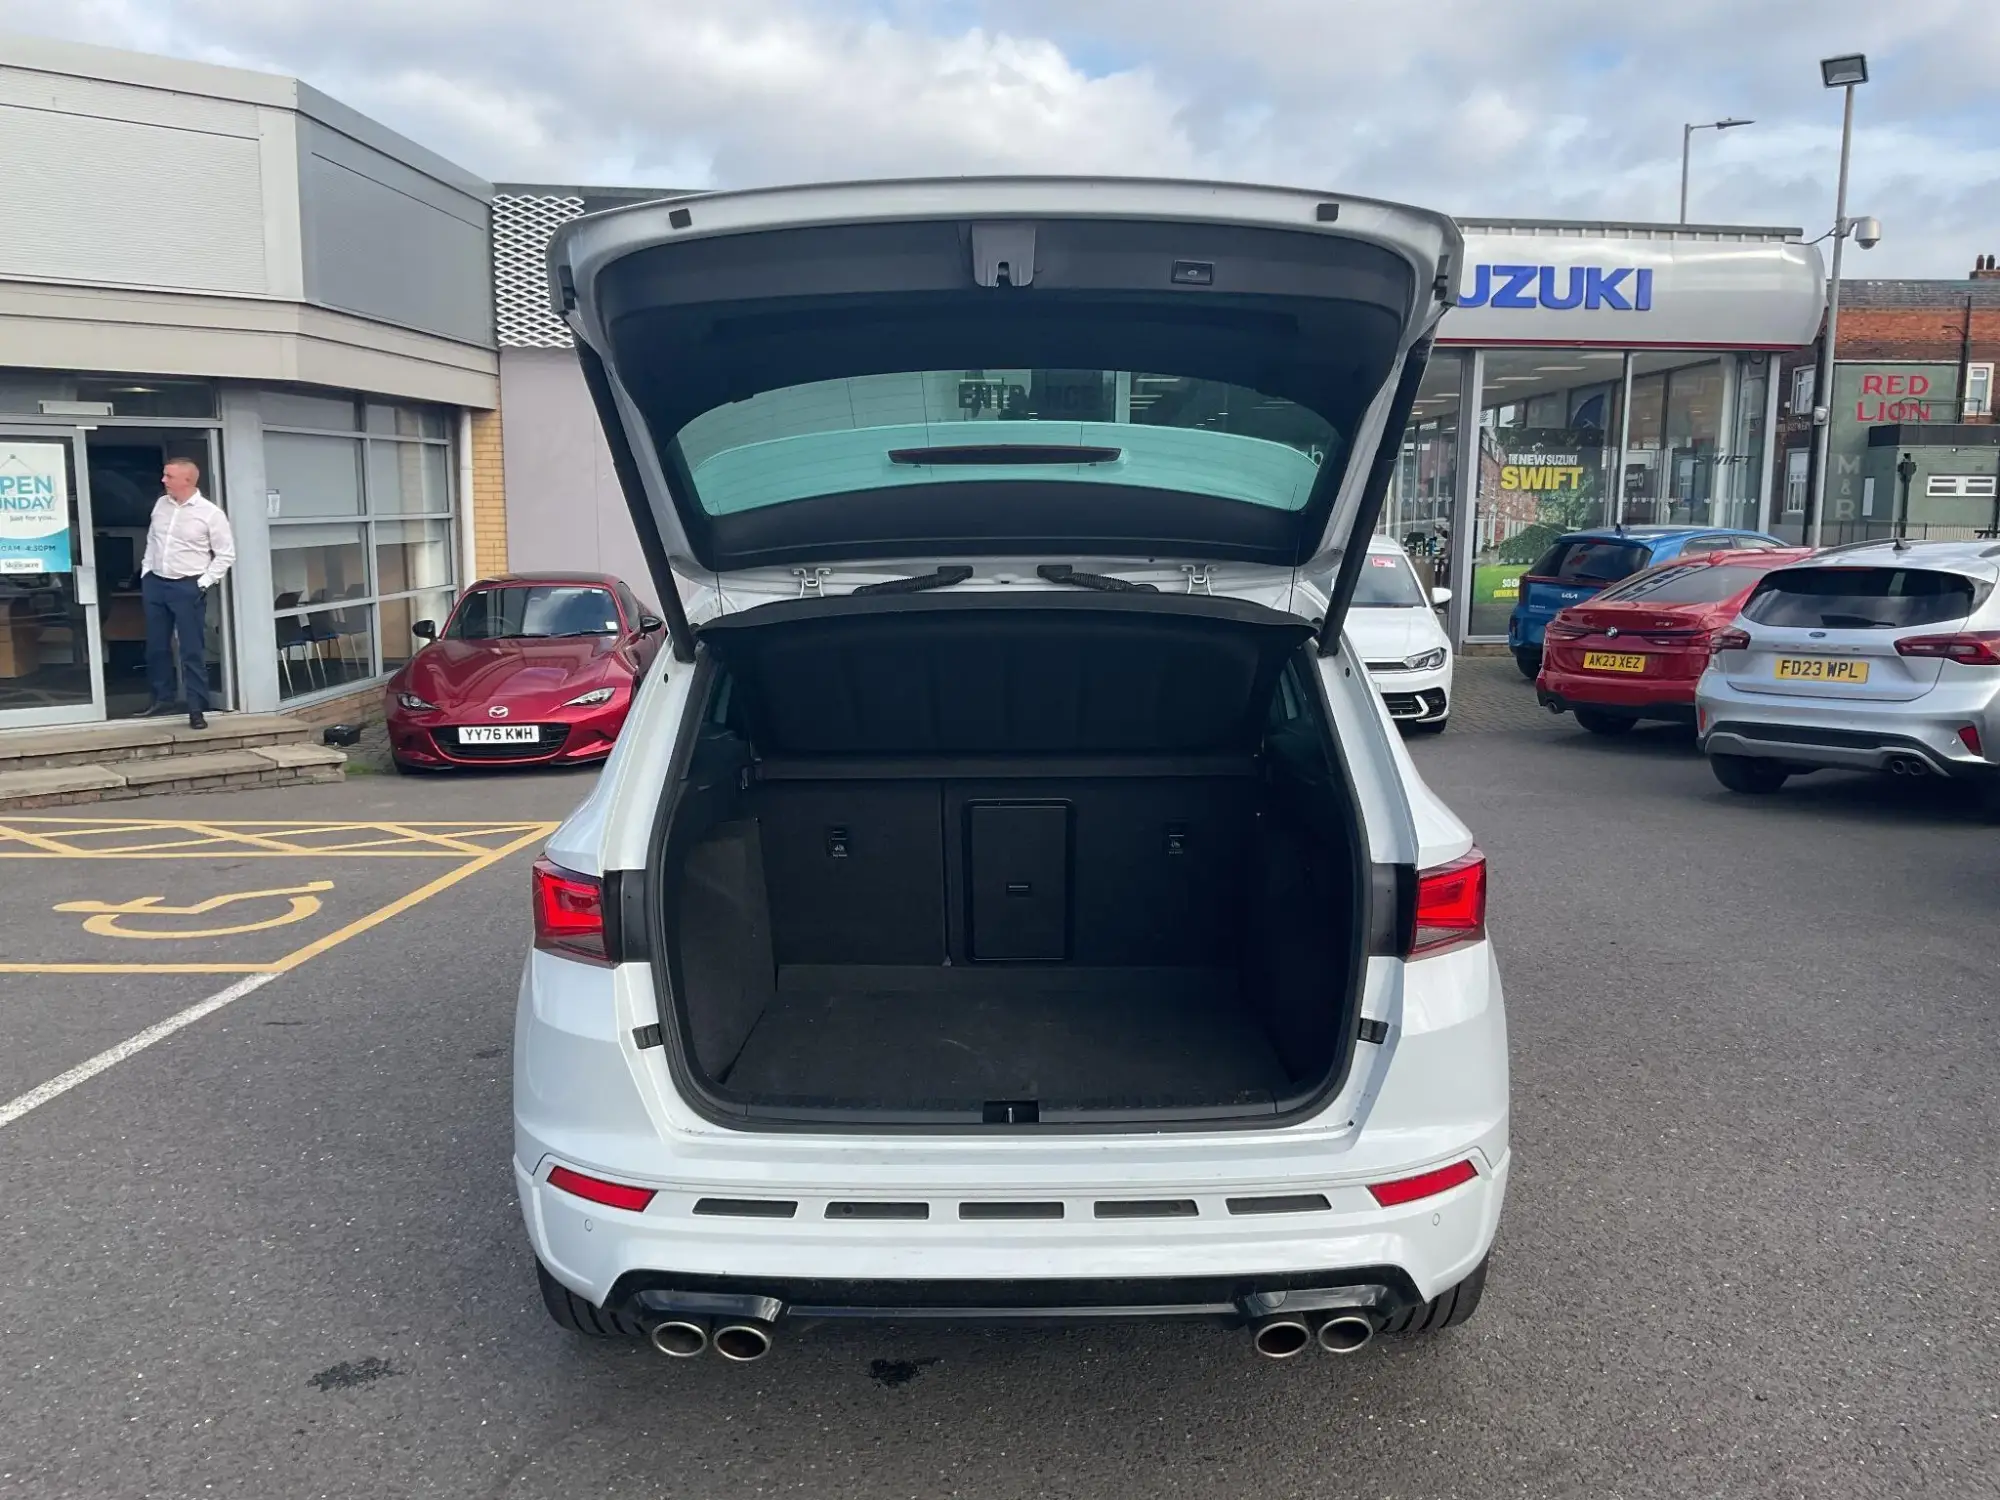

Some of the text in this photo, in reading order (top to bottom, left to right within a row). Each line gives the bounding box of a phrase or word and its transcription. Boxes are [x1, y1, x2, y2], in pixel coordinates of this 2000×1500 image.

[1457, 264, 1653, 311] UZUKI
[1862, 374, 1930, 396] RED
[958, 384, 1098, 410] ENTRNCE
[1856, 401, 1931, 422] LION
[1518, 454, 1546, 466] NEW
[1546, 454, 1578, 466] SUZUKI
[1836, 454, 1862, 476] M
[0, 475, 53, 495] PEN
[1500, 466, 1584, 490] SWIFT
[0, 495, 55, 511] NDAY
[1834, 499, 1857, 521] R
[1588, 655, 1641, 669] AK23 XEZ
[1780, 659, 1859, 678] FD23 WPL
[465, 727, 533, 741] YY76 KWH
